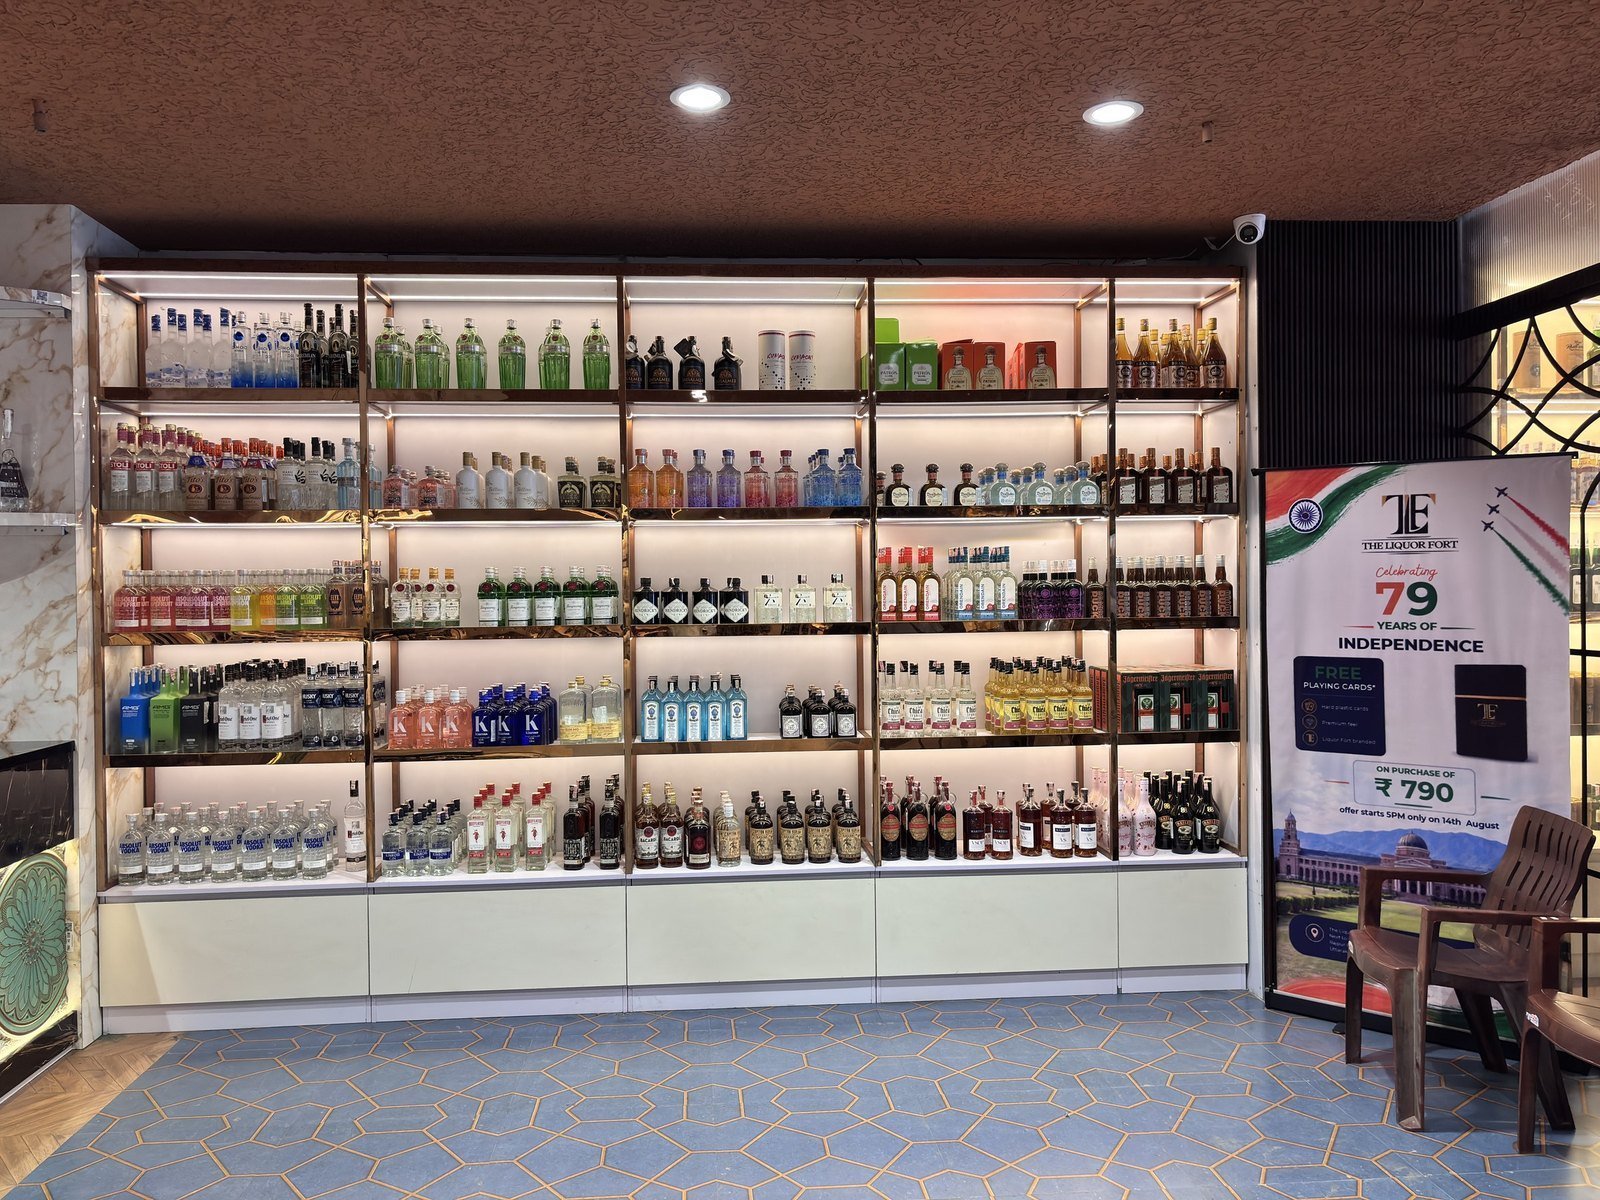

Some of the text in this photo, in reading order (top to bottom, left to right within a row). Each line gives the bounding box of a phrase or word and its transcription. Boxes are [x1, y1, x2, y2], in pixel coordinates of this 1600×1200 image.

[1362, 540, 1458, 550] THE LIQUOR FORT
[1376, 564, 1438, 581] Celebrating
[1376, 582, 1438, 616] 79
[1377, 622, 1437, 630] YEARS OF
[1339, 637, 1484, 652] INDEPENDENCE
[1315, 666, 1362, 679] FREE
[393, 716, 406, 732] K
[421, 716, 434, 732] K
[447, 716, 458, 732] K
[475, 716, 488, 732] K
[498, 715, 510, 732] K
[525, 714, 539, 731] K
[1392, 768, 1440, 777] PURCHASE
[1374, 777, 1454, 802] ₹ 790
[1339, 806, 1358, 815] offer
[1361, 808, 1384, 817] starts
[1408, 814, 1426, 823] only
[1442, 817, 1461, 826] 14th
[1466, 820, 1499, 830] August
